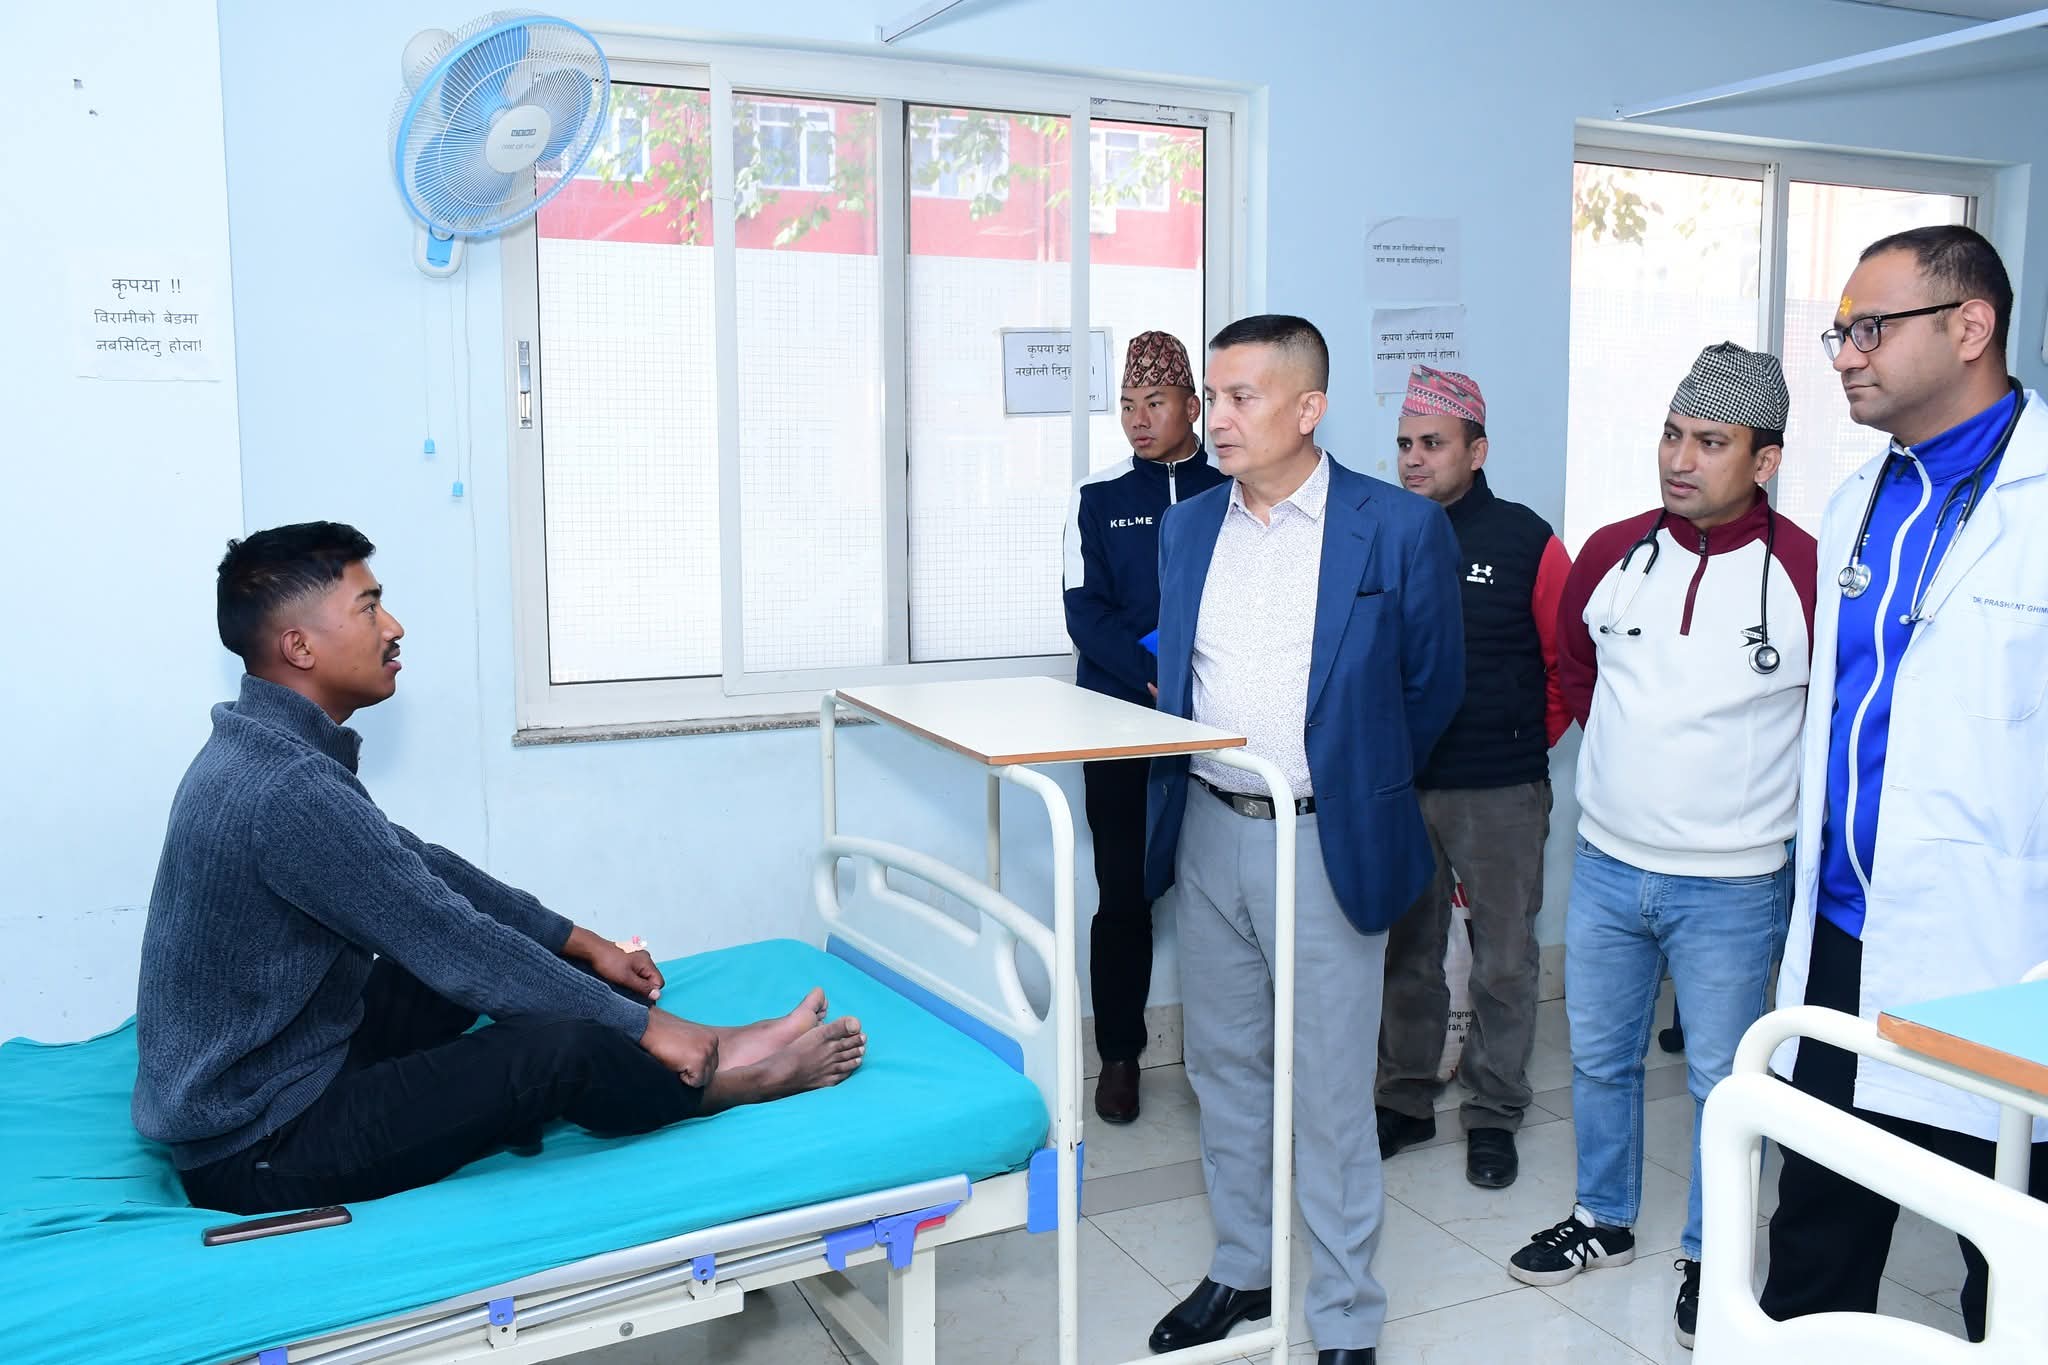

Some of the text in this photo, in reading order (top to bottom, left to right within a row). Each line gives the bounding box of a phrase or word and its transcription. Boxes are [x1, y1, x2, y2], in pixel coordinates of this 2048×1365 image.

[112, 278, 181, 300] कृपया !!
[94, 308, 198, 325] विरामीको बेडमा
[1381, 332, 1403, 346] कृपया
[96, 336, 162, 357] नबसिदिनु
[1027, 344, 1054, 359] कृपया
[1014, 363, 1049, 377] नखोली
[1110, 516, 1153, 529] KELME
[2026, 605, 2048, 615] GHIM
